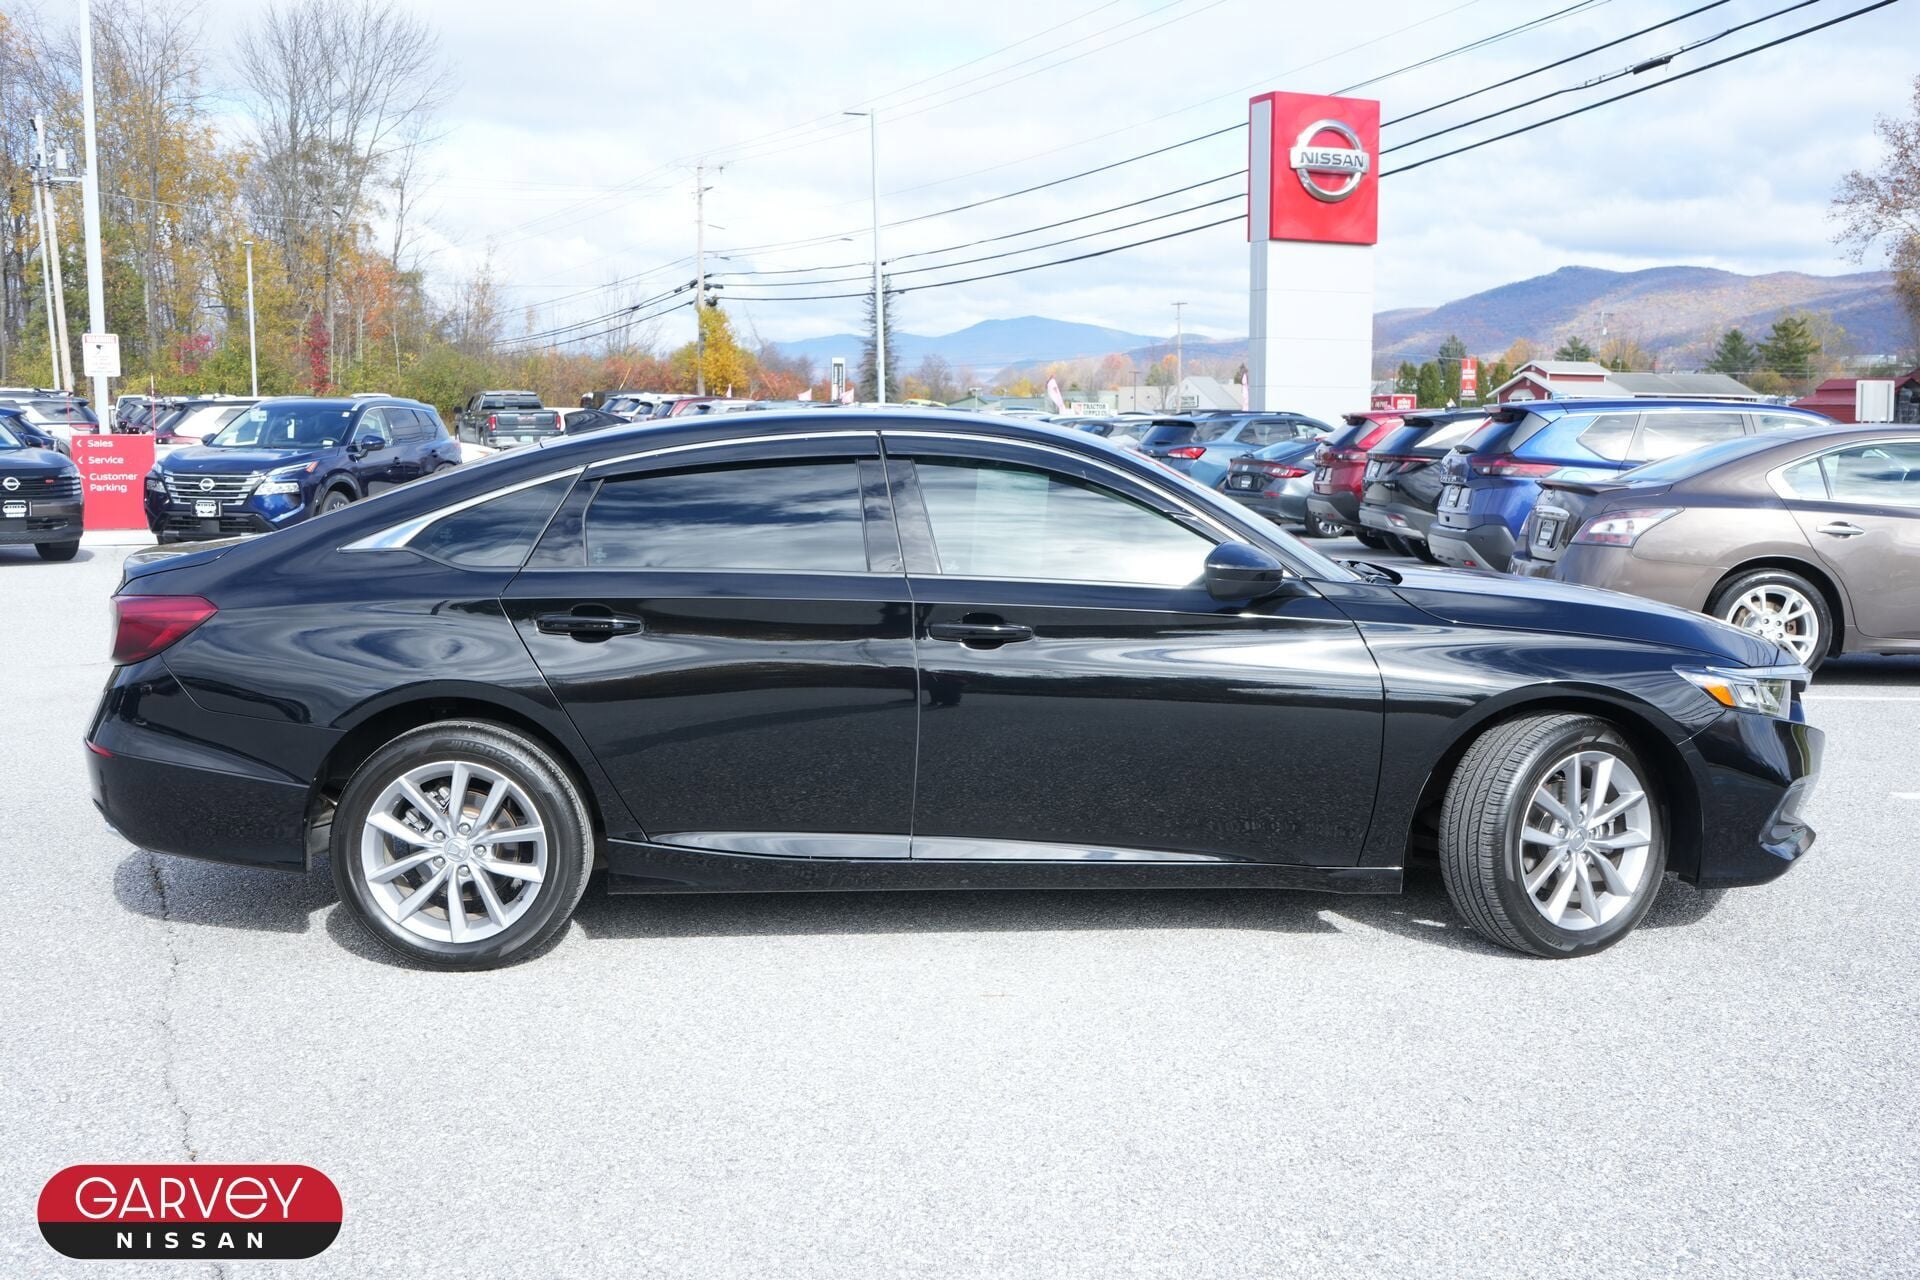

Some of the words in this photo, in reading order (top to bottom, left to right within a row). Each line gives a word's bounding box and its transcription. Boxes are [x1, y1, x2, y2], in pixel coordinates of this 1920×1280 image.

[1301, 151, 1364, 168] NISSAN
[87, 439, 113, 448] Sales
[88, 456, 124, 464] Service
[89, 473, 137, 481] Customer
[90, 483, 127, 493] Parking
